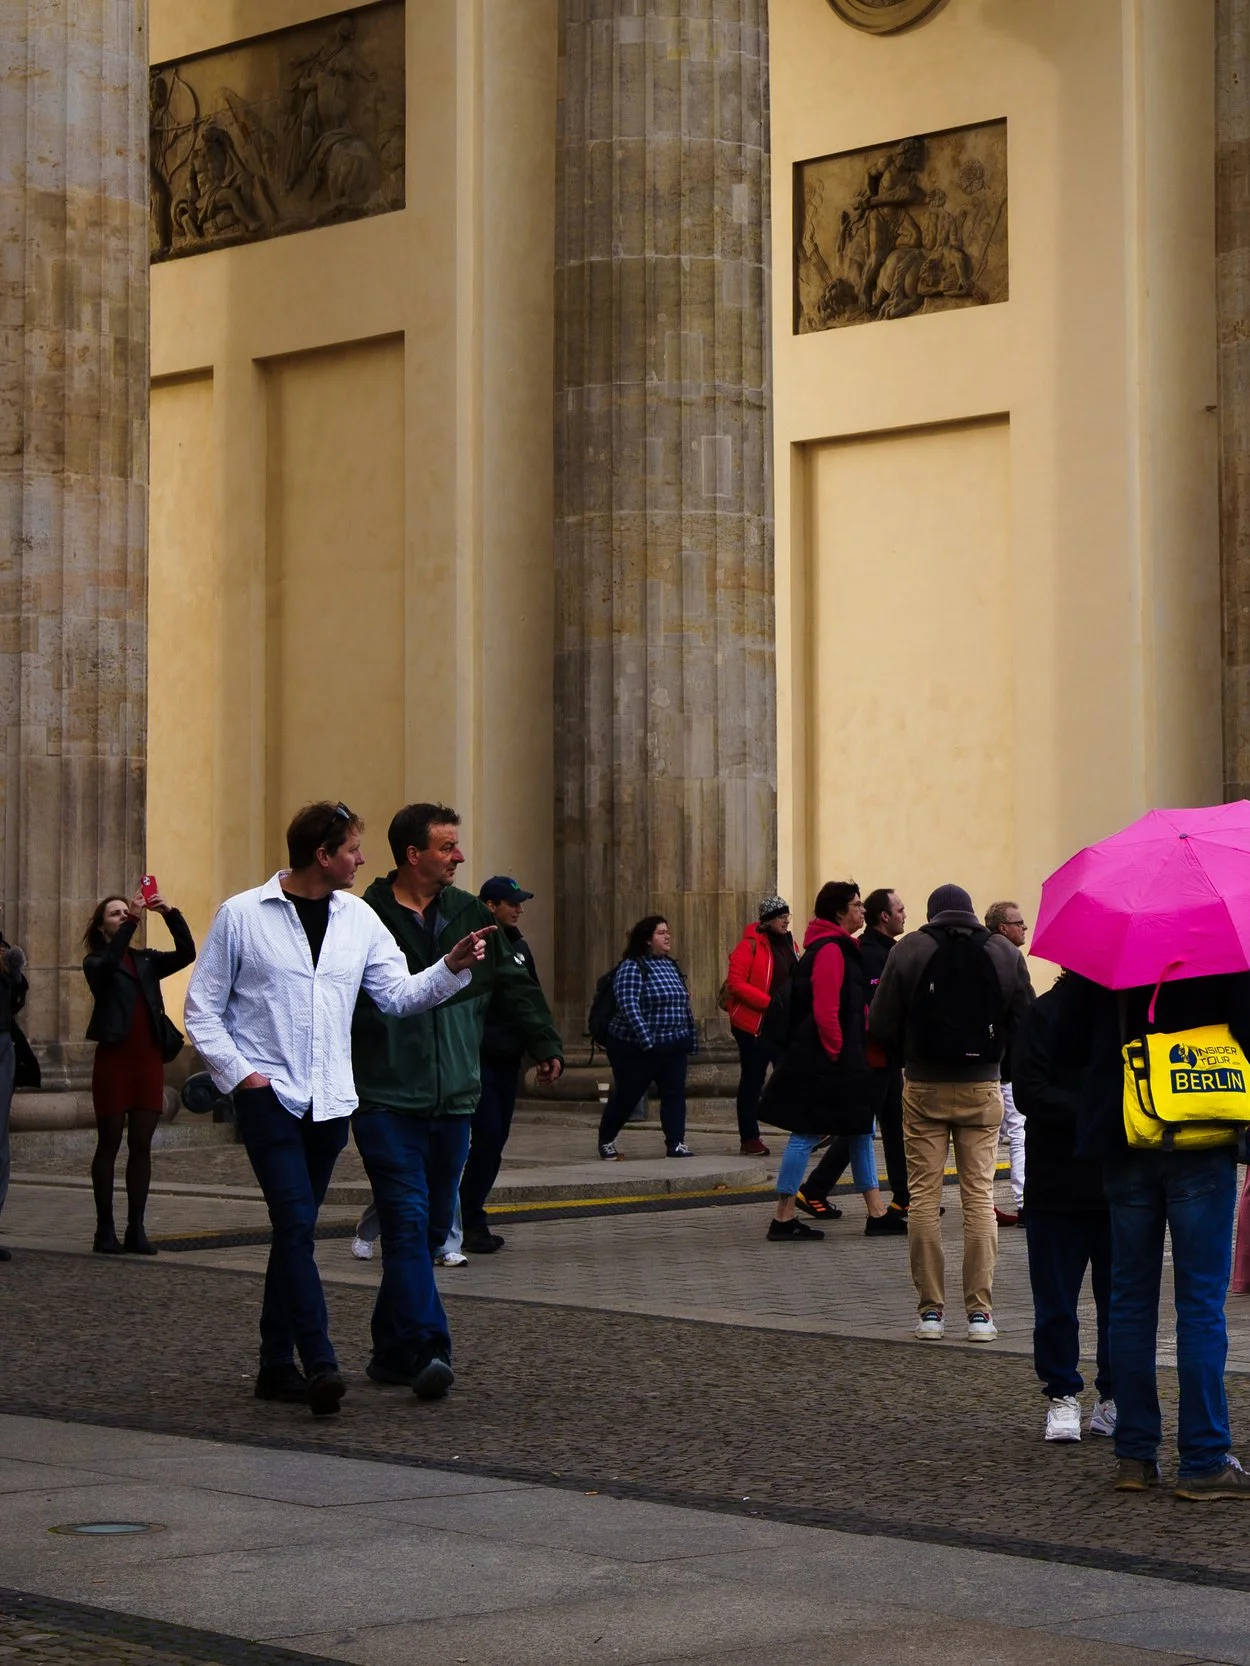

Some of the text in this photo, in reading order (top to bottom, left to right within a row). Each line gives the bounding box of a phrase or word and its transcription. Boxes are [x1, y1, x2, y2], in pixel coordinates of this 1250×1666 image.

[1196, 1046, 1238, 1057] INSIDER
[1199, 1056, 1231, 1066] TOUR
[1175, 1071, 1243, 1090] BERLIN
